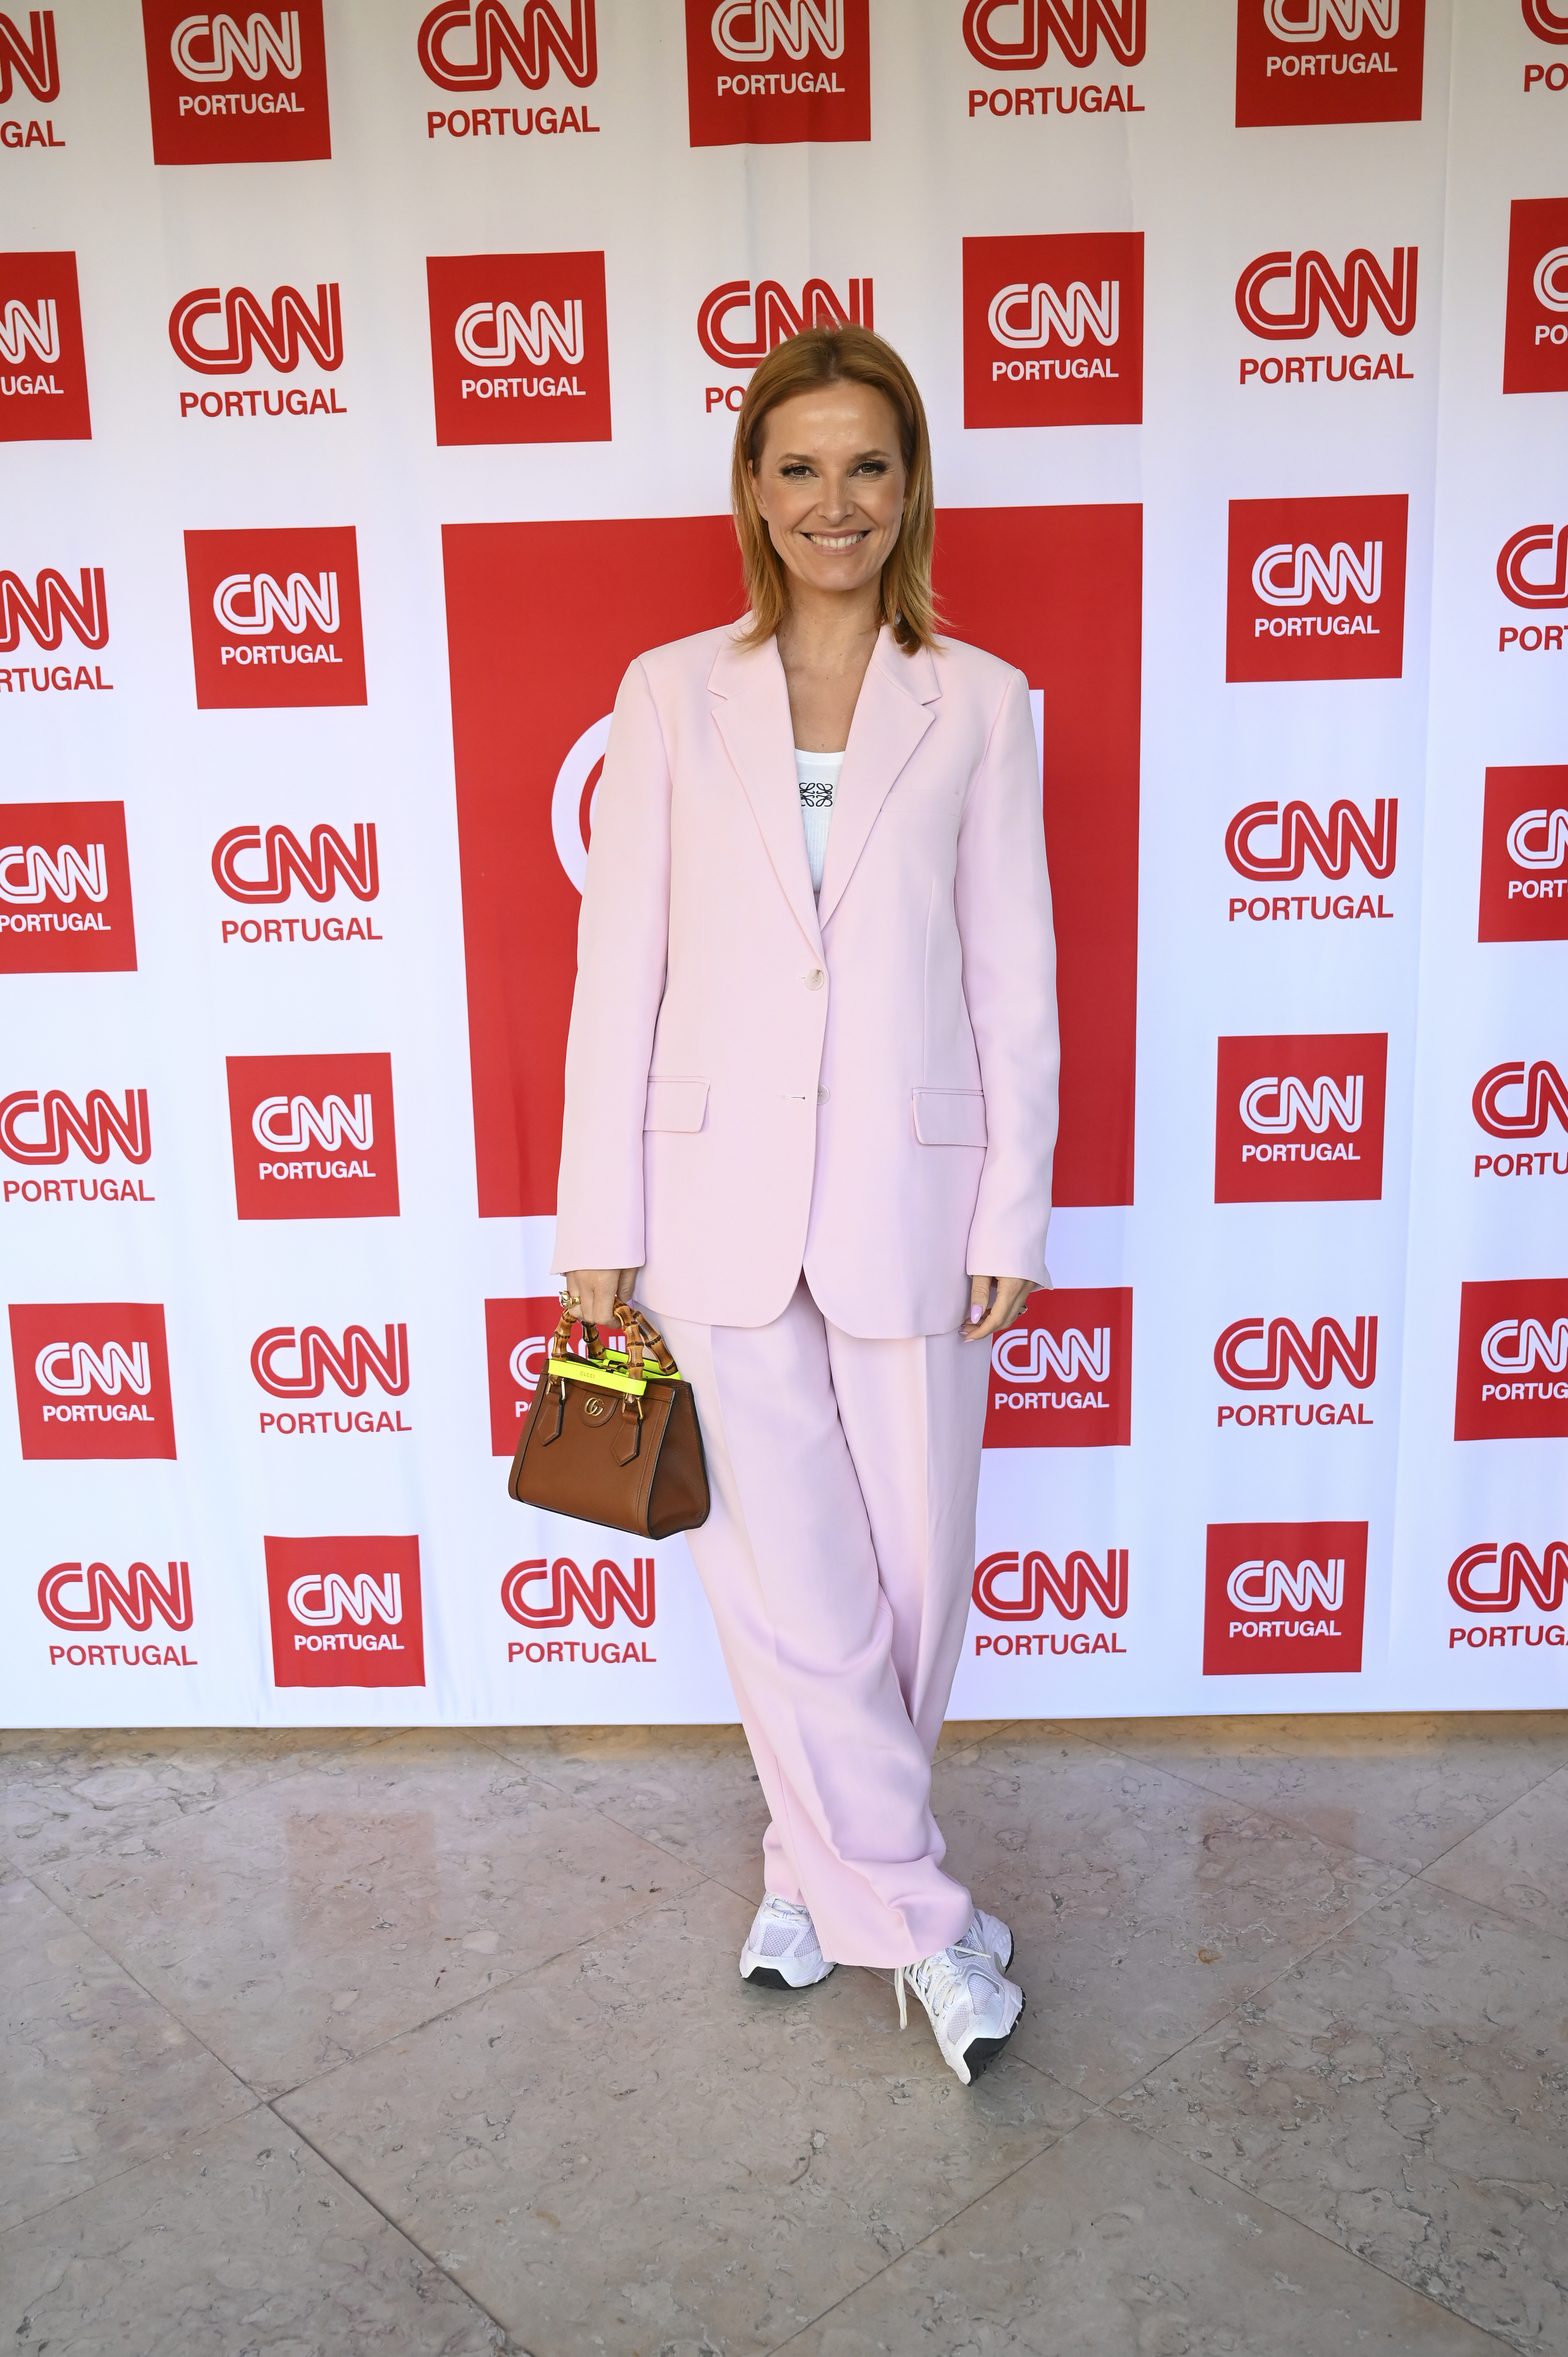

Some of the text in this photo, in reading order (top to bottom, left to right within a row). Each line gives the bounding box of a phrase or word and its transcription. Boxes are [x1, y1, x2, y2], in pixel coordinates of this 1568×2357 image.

[170, 10, 302, 82] CNN
[418, 0, 597, 91] CNN
[711, 0, 844, 62] CNN
[963, 0, 1146, 70] CNN
[1266, 51, 1398, 77] PORTUGAL
[717, 71, 845, 96] PORTUGAL
[179, 91, 305, 115] PORTUGAL
[969, 85, 1144, 116] PORTUGAL
[428, 105, 599, 137] PORTUGAL
[1235, 246, 1418, 339] CNN
[169, 283, 343, 374] CNN
[988, 280, 1120, 349] CNN
[454, 299, 584, 367] CNN
[992, 357, 1119, 381] PORTUGAL
[1240, 353, 1414, 384] PORTUGAL
[0, 374, 64, 395] UGAL
[461, 376, 586, 399] PORTUGAL
[180, 388, 346, 417] PORTUGAL
[1252, 540, 1383, 606] CNN
[0, 568, 109, 652] NN
[213, 572, 340, 635] CNN
[1255, 615, 1380, 637] PORTUGAL
[221, 643, 343, 665] PORTUGAL
[0, 666, 113, 691] RTUGAL
[1225, 798, 1398, 881] CNN
[0, 843, 108, 904] CNN
[212, 823, 379, 903] CNN
[1508, 879, 1568, 899] PORT
[0, 912, 111, 933] PORTUGAL
[1230, 895, 1393, 920] PORTUGAL
[222, 917, 382, 942] PORTUGAL
[1239, 1074, 1364, 1134] CNN
[1472, 1061, 1568, 1138] CN
[0, 1089, 151, 1164] CNN
[252, 1093, 374, 1153] CNN
[1242, 1142, 1361, 1162] PORTUGAL
[1475, 1152, 1568, 1176] PORTU
[259, 1160, 376, 1180] PORTUGAL
[4, 1179, 154, 1201] PORTUGAL
[250, 1323, 410, 1398] CNN
[991, 1327, 1111, 1384] CNN
[1214, 1316, 1378, 1390] CNN
[1480, 1317, 1568, 1374] CN
[35, 1341, 151, 1396] CNN
[995, 1391, 1110, 1409] PORTUGAL
[1482, 1381, 1568, 1401] PORTUG
[42, 1404, 155, 1422] PORTUGAL
[260, 1411, 411, 1434] PORTUGAL
[1218, 1404, 1373, 1426] PORTUGAL
[38, 1562, 193, 1631] CNN
[287, 1572, 402, 1626] CNN
[501, 1557, 655, 1629] CNN
[972, 1549, 1128, 1620] CNN
[1226, 1558, 1345, 1613] CNN
[294, 1633, 405, 1652] PORTUGAL
[976, 1633, 1126, 1655] PORTUGAL
[1229, 1619, 1342, 1638] PORTUGAL
[1450, 1625, 1568, 1648] PORTUG
[49, 1645, 197, 1665] PORTUGAL
[509, 1642, 656, 1663] PORTUGAL
